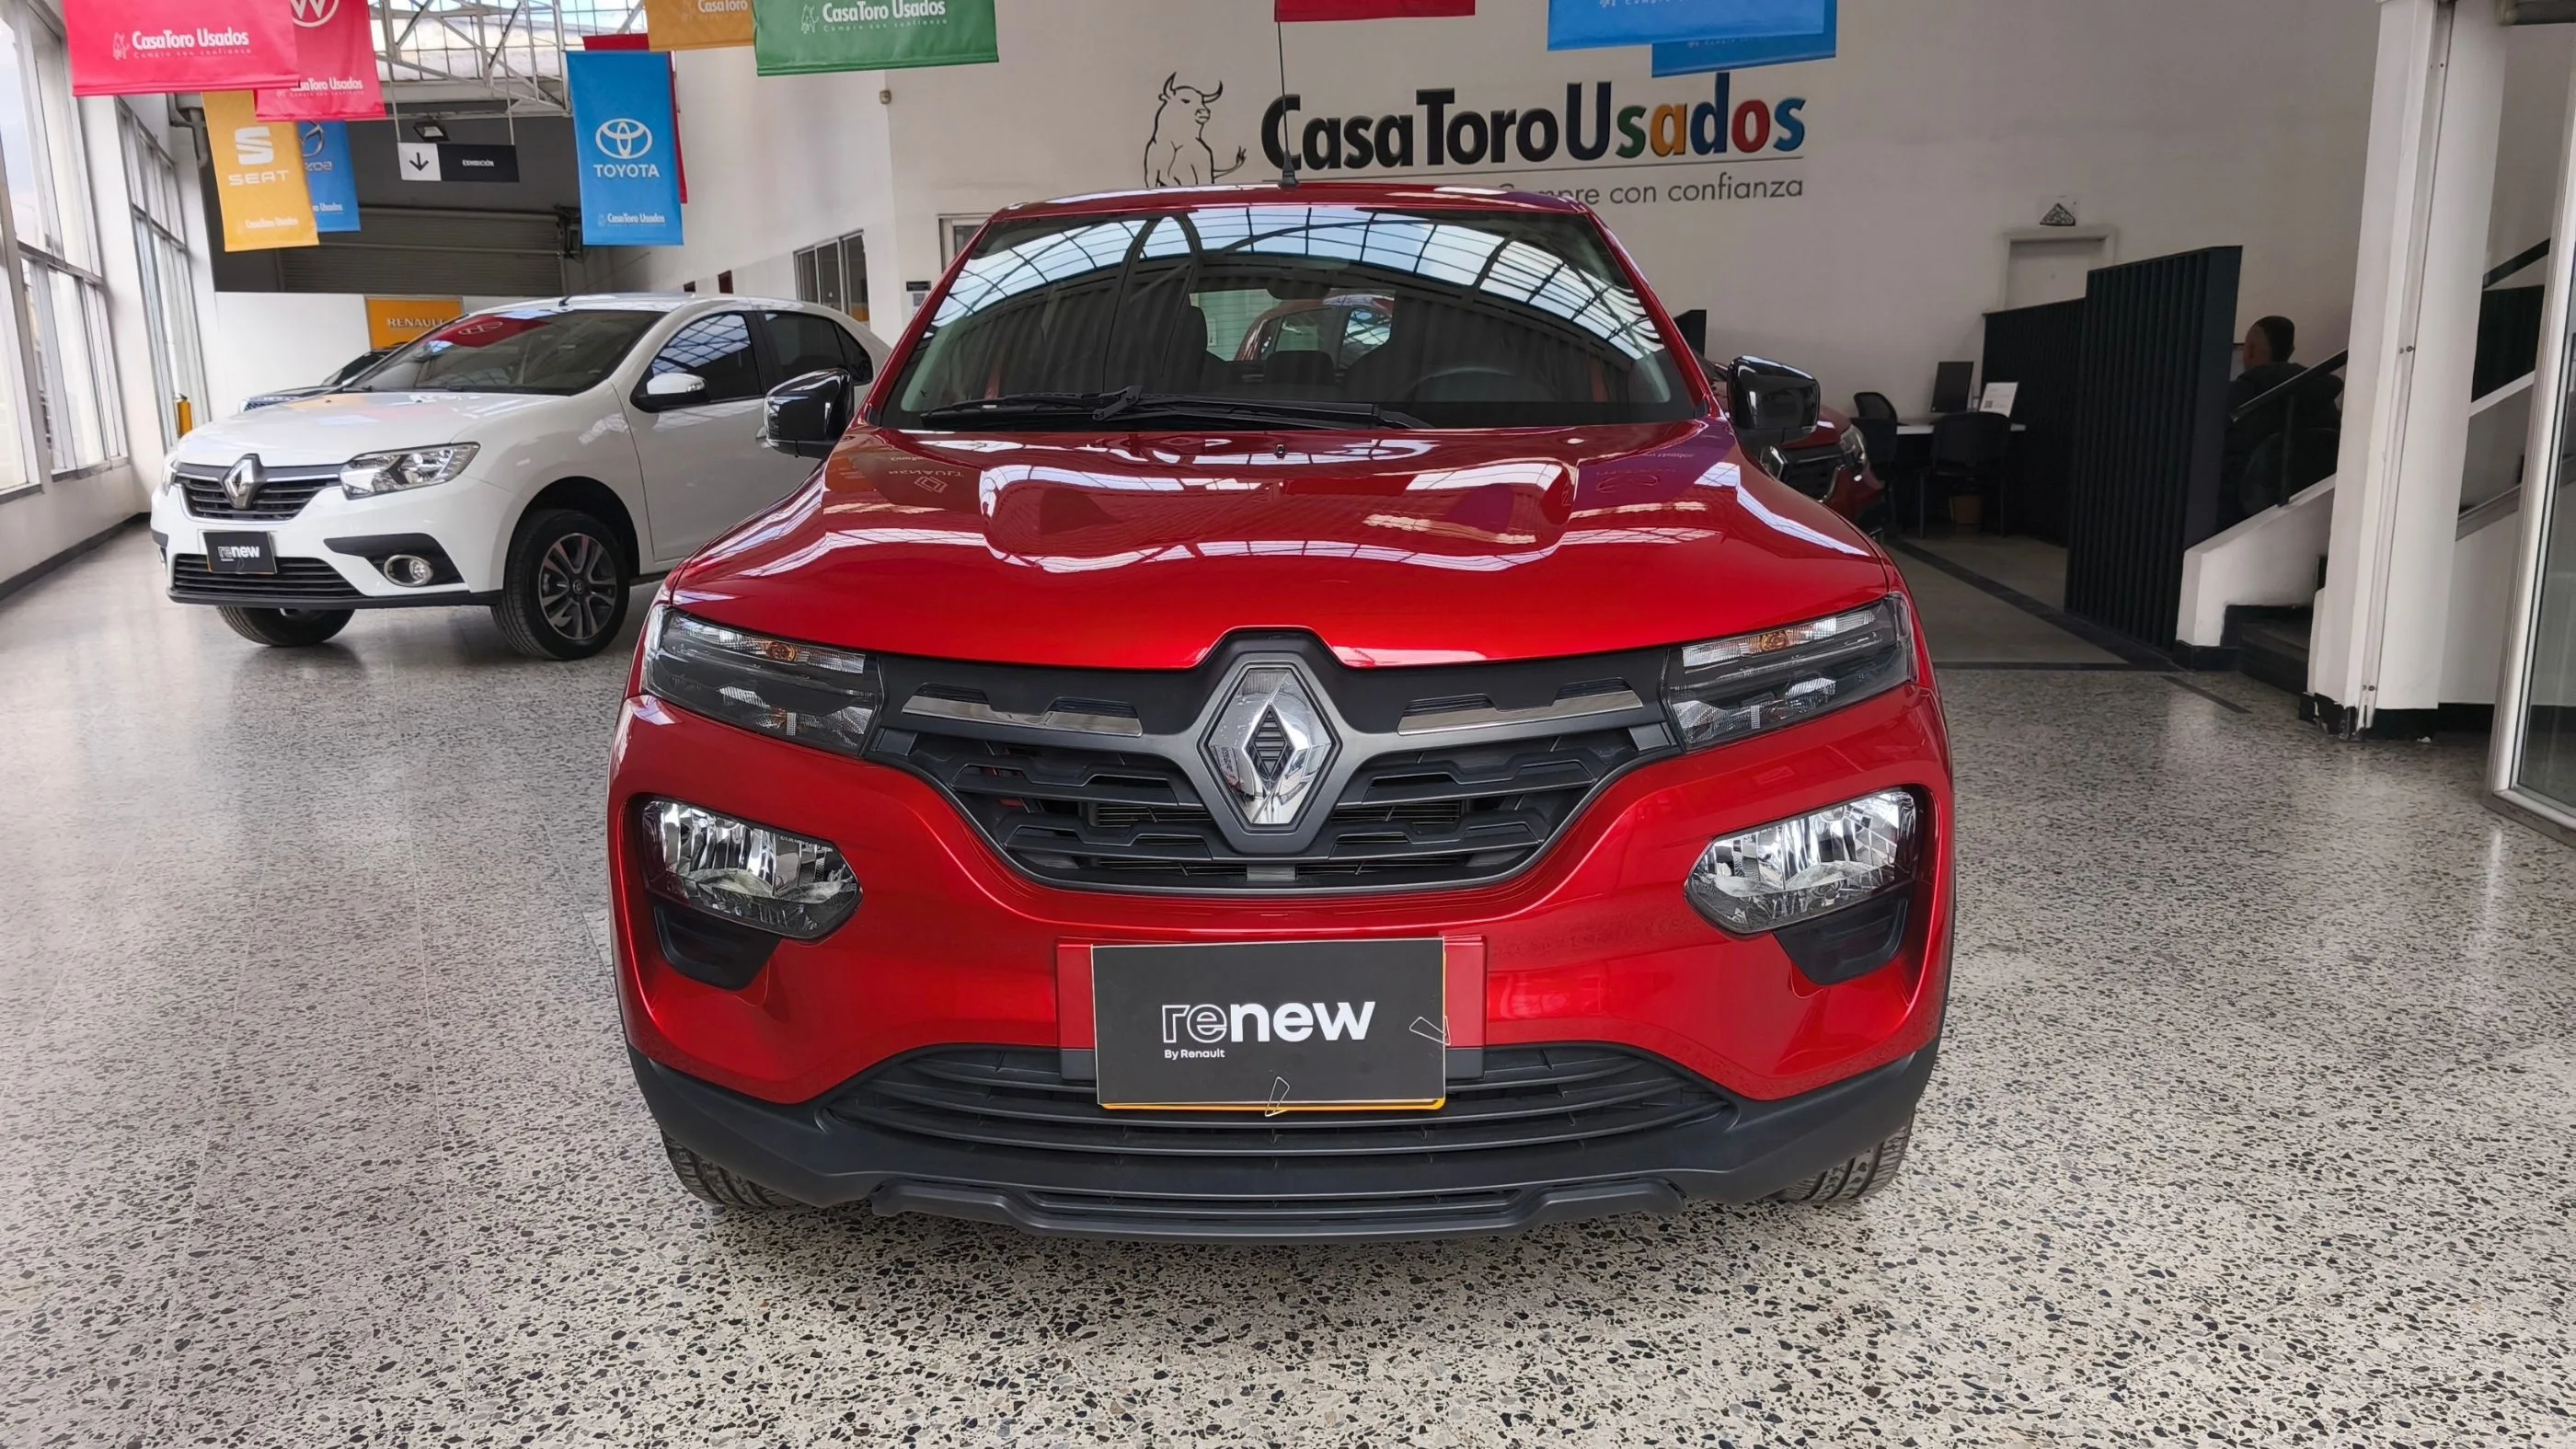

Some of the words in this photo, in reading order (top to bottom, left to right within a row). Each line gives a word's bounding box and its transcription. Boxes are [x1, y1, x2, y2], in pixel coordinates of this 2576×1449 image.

[697, 0, 748, 13] CasaToro
[822, 0, 889, 23] CasaToro
[891, 0, 947, 18] Usados
[132, 29, 195, 50] CasaToro
[196, 27, 249, 47] Usados
[328, 76, 363, 90] Usados
[305, 160, 333, 171] zda
[592, 164, 661, 178] TOYOTA
[227, 169, 289, 186] SEAT
[1610, 184, 1656, 204] con
[1667, 172, 1803, 202] confianza
[607, 213, 639, 223] CasaToro
[639, 213, 665, 223] Usados
[386, 317, 447, 328] RENAUL
[217, 546, 260, 558] renew
[1161, 1001, 1376, 1043] renew
[1164, 1049, 1179, 1061] By
[1180, 1048, 1225, 1059] Renault
